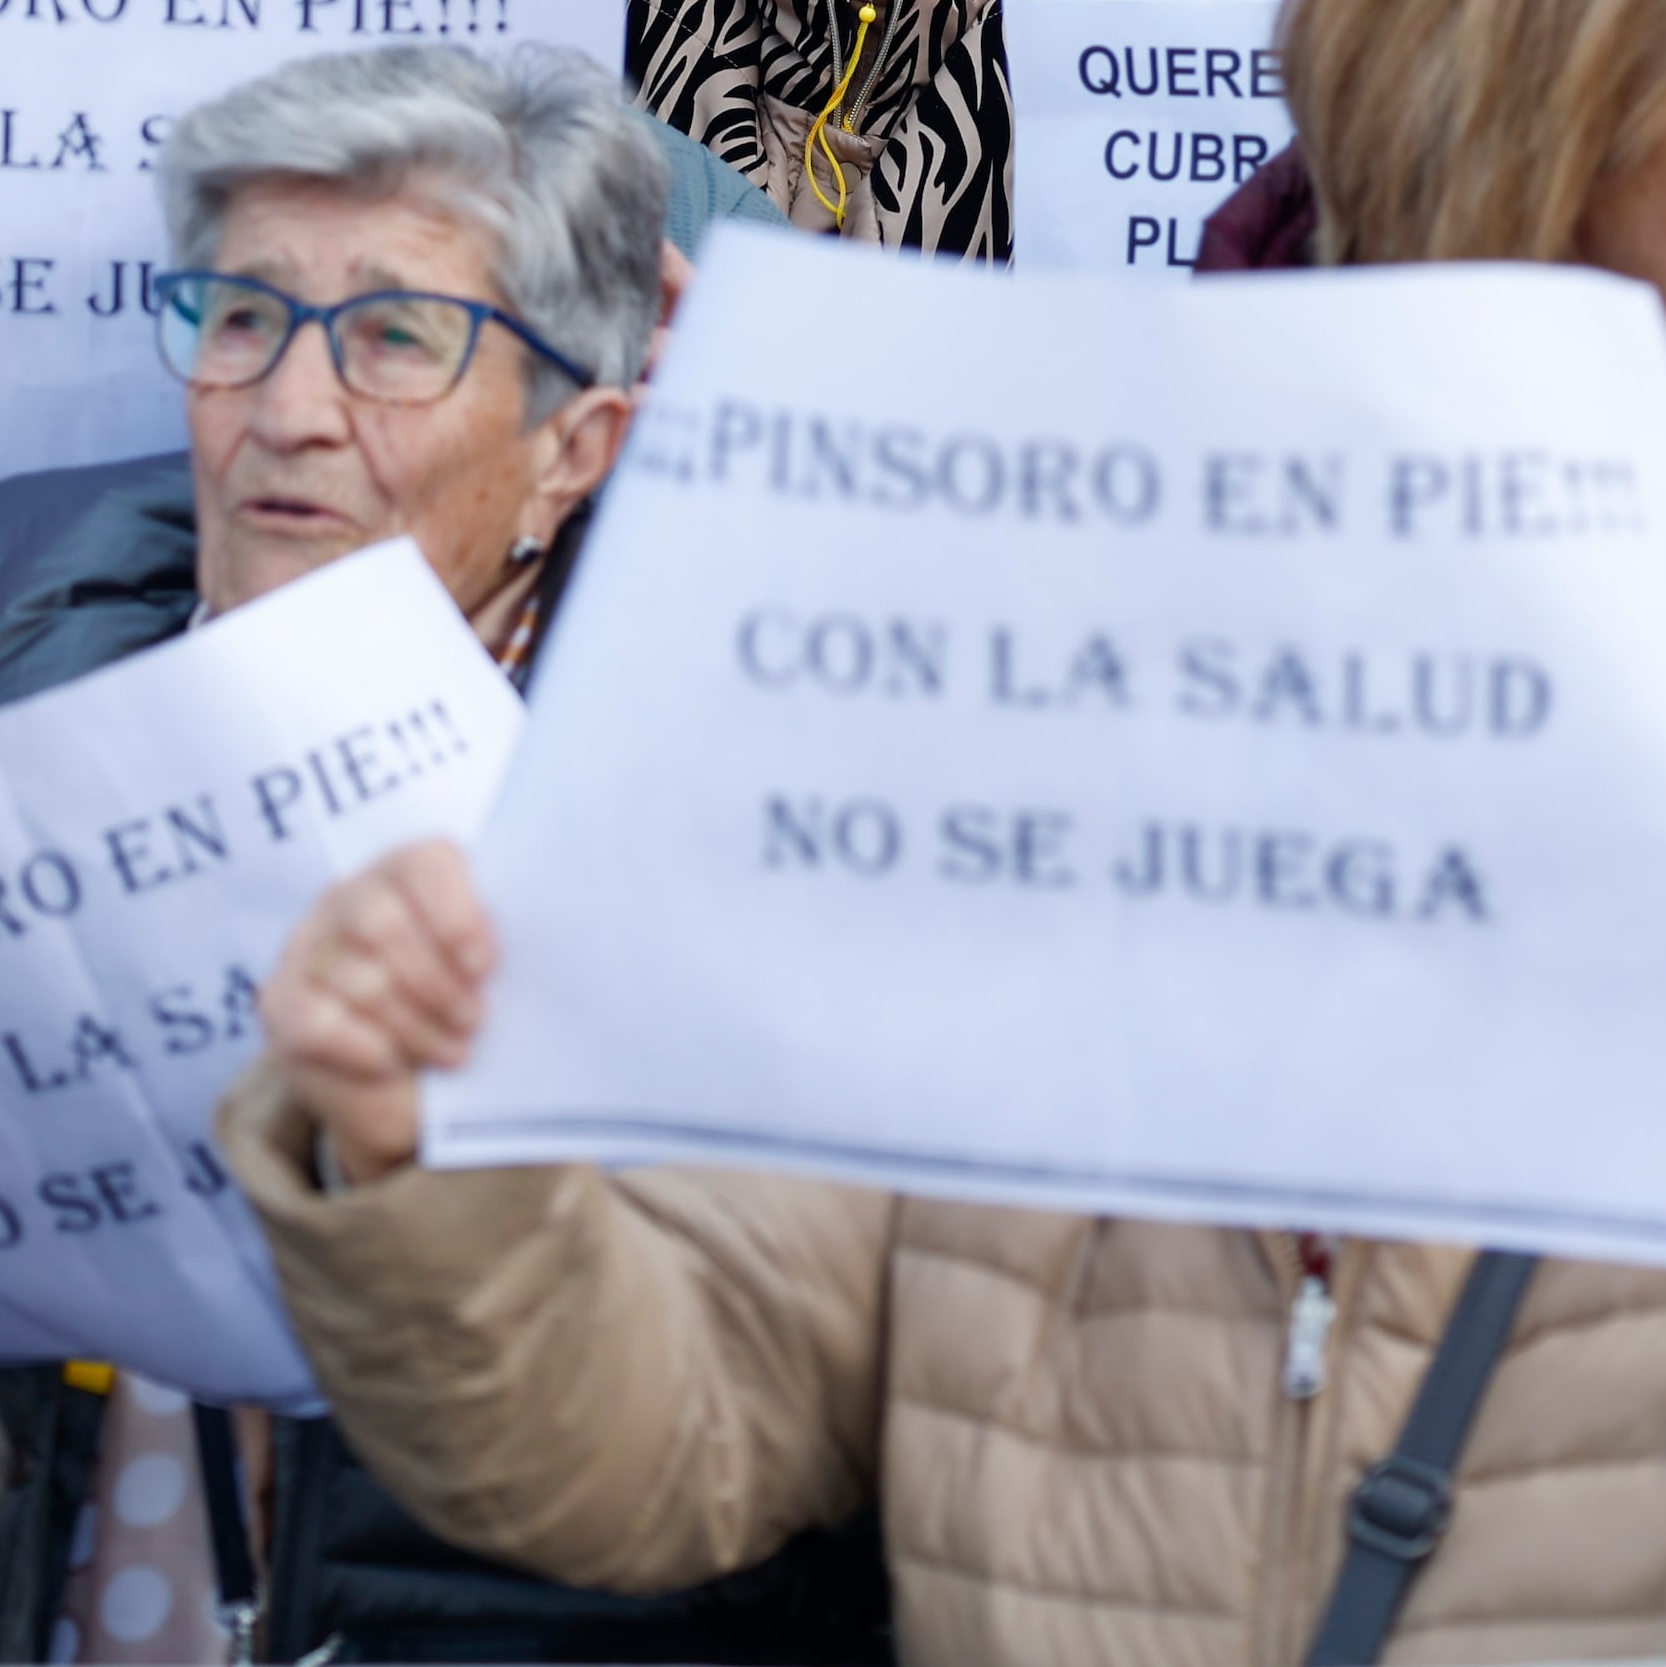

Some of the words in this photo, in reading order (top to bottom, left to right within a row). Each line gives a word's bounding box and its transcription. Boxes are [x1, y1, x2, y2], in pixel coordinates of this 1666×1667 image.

[0, 109, 108, 172] LA
[1203, 453, 1335, 536] EN
[1388, 452, 1647, 536] PIE!!!
[737, 609, 946, 695] CON
[989, 624, 1130, 709] LA
[1176, 638, 1552, 738] SALUD
[104, 794, 230, 894] EN
[253, 701, 469, 844] PIE!!!
[760, 794, 899, 877] NO
[937, 808, 1077, 890] SE
[1115, 823, 1493, 926] JUEGA
[1, 1014, 135, 1093] LA
[40, 1160, 162, 1234] SE
